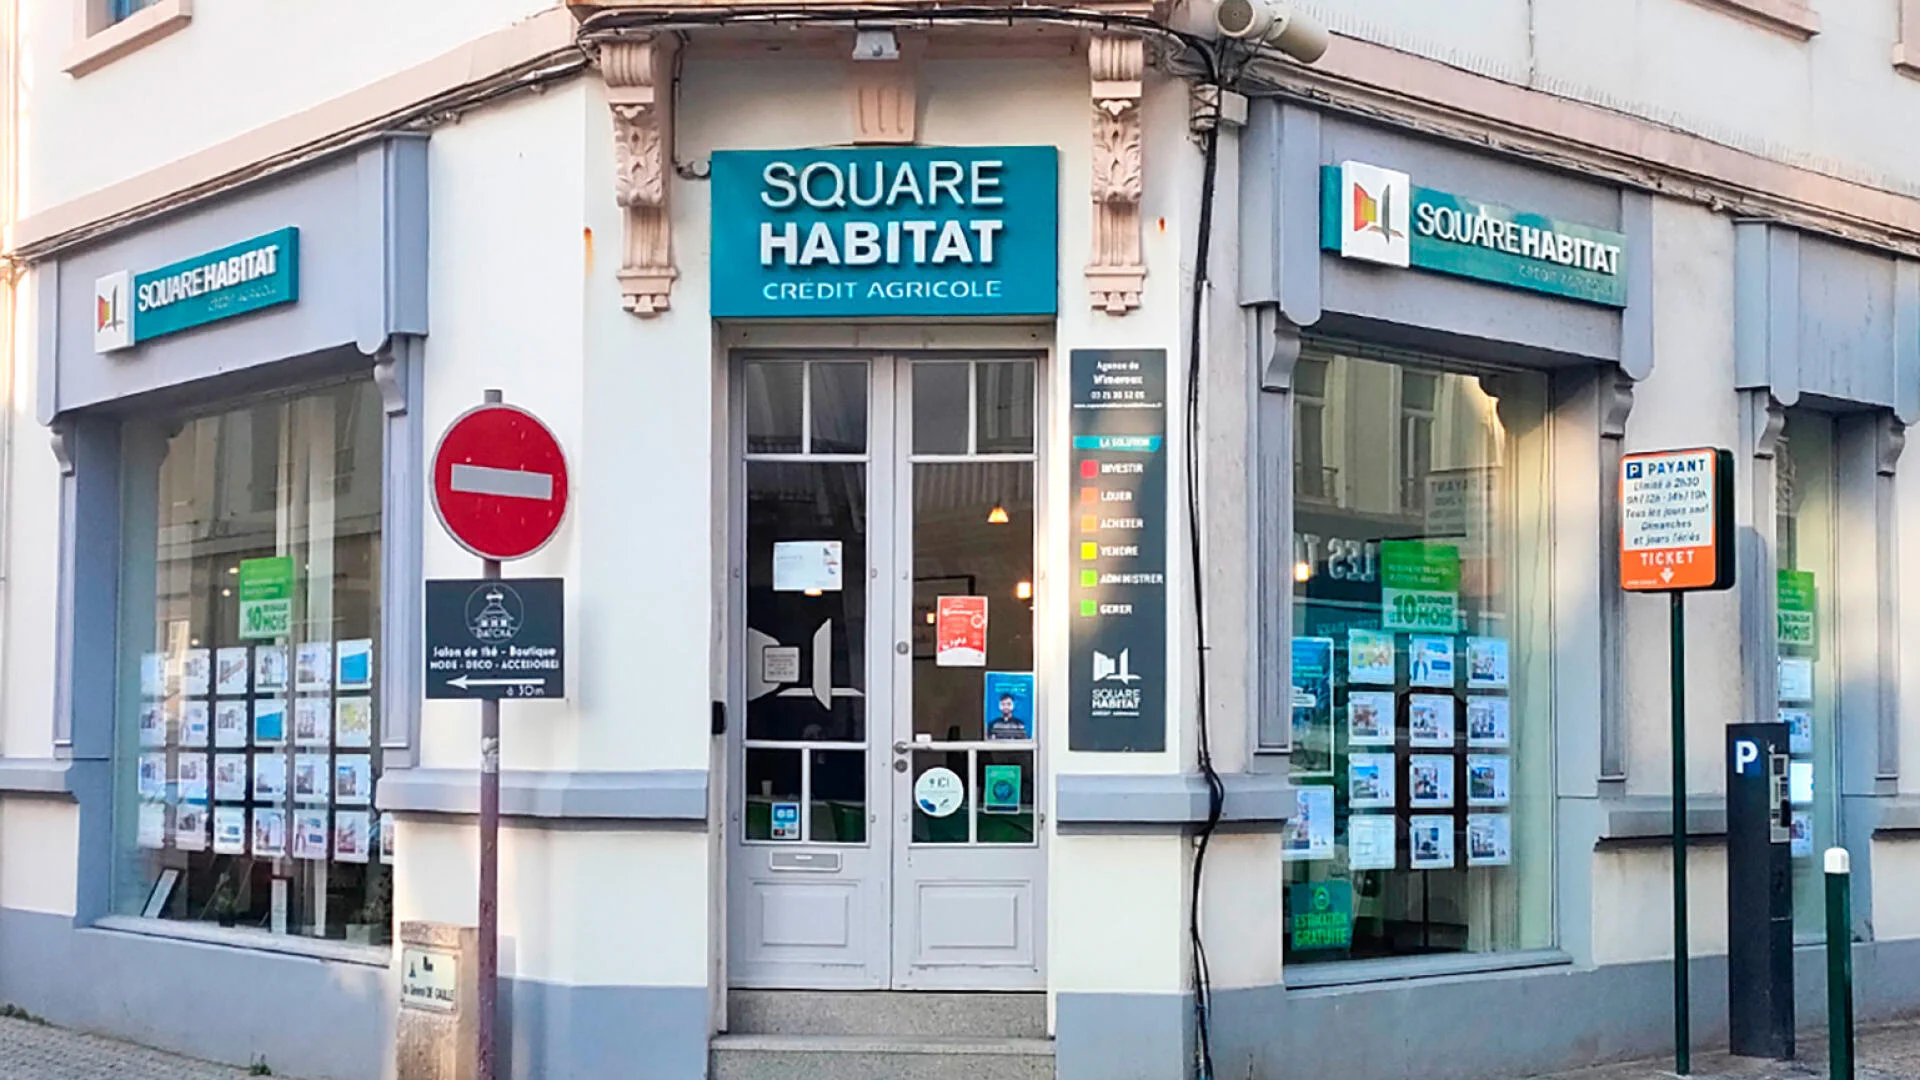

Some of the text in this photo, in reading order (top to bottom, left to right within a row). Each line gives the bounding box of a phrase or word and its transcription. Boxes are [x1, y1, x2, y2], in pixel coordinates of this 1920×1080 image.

[760, 160, 1004, 208] SQUARE
[760, 220, 1004, 266] HABITAT
[866, 280, 1003, 299] AGRICOLE
[1101, 462, 1144, 473] INVESTIR
[1648, 458, 1706, 477] PAYANT
[1100, 490, 1133, 502] LOUER
[1099, 518, 1144, 529] ACHETER
[1099, 545, 1139, 557] VENDRE
[1639, 550, 1695, 566] TICKET
[1099, 573, 1164, 584] ADMINISTRER
[1392, 594, 1416, 624] 10
[1417, 606, 1453, 626] MOIS
[432, 646, 462, 658] Salon
[464, 646, 479, 657] de
[480, 646, 498, 657] thé
[509, 645, 558, 658] Boutique
[430, 660, 457, 669] MODE
[500, 659, 560, 669] ACCESSOIRES
[1091, 688, 1141, 699] SQUARE
[1091, 698, 1141, 709] HABITAT
[1735, 740, 1760, 774] P
